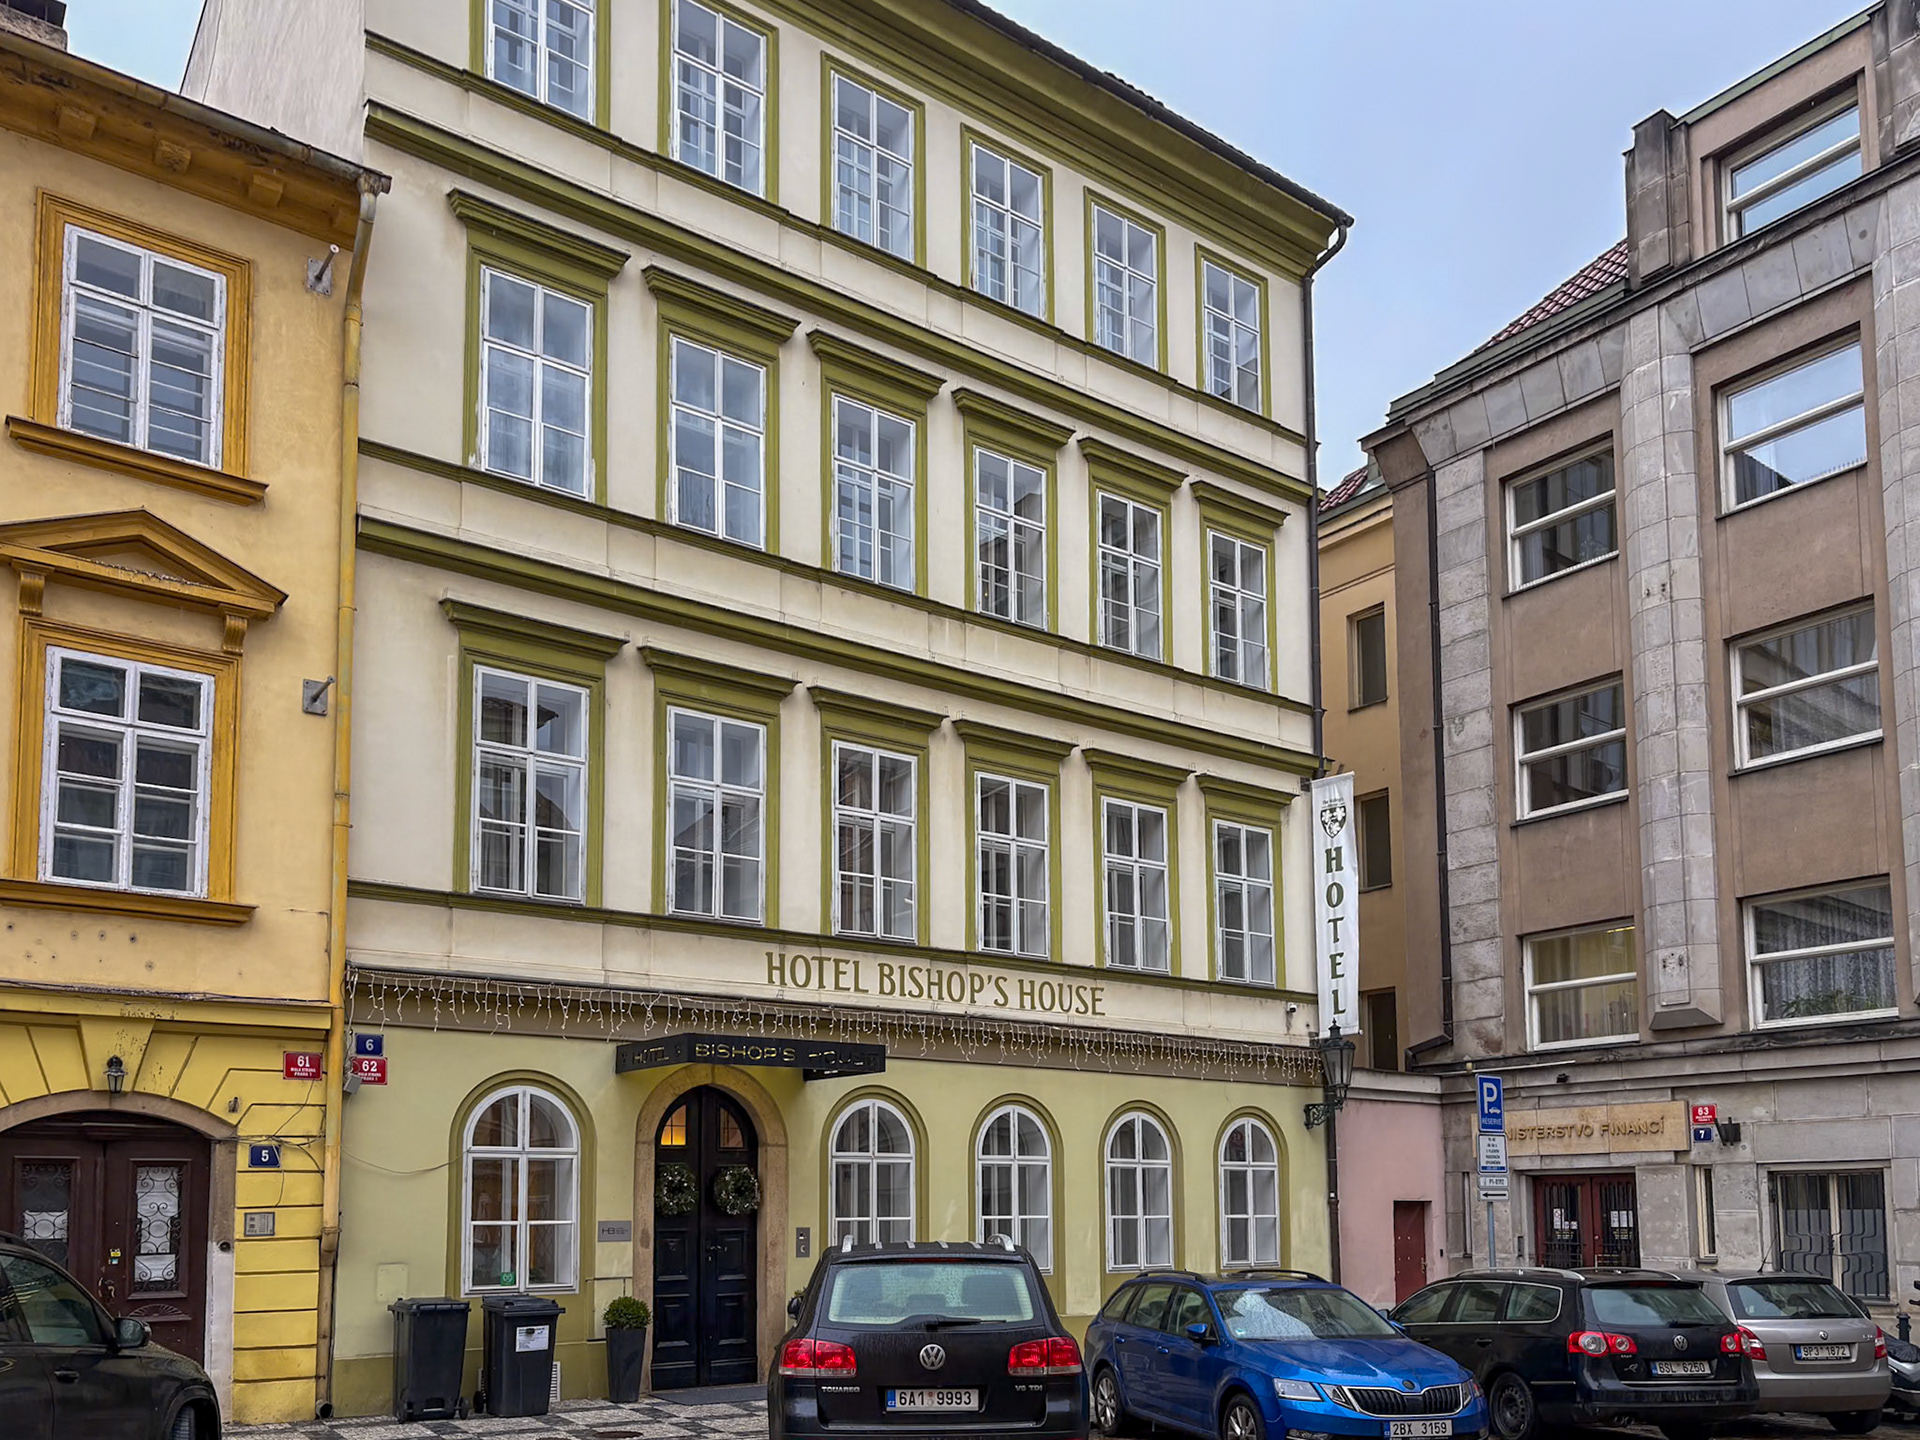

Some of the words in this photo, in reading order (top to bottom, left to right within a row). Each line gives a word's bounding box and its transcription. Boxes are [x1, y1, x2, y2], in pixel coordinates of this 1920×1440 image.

[1325, 846, 1346, 1015] HOTEL
[765, 951, 869, 994] HOTEL
[877, 963, 1009, 1008] BISHOP'S
[1018, 978, 1106, 1016] HOUSE
[365, 1039, 374, 1051] 6
[695, 1043, 796, 1062] BISHOP'S
[297, 1055, 310, 1068] 61
[362, 1060, 378, 1072] 62
[1482, 1082, 1498, 1114] P
[1698, 1106, 1709, 1116] 63
[1505, 1123, 1594, 1141] NISTERSTVO
[1600, 1115, 1665, 1135] FINANCÍ
[1699, 1130, 1705, 1139] 7
[261, 1149, 269, 1162] 5
[1803, 1346, 1820, 1356] 9P3
[1825, 1345, 1847, 1356] 1872
[1682, 1362, 1705, 1373] 6250
[1028, 1384, 1043, 1392] TDI
[899, 1391, 925, 1406] 6A1
[936, 1391, 972, 1405] 9993
[1393, 1423, 1413, 1435] 2BX
[1421, 1421, 1447, 1435] 3159
